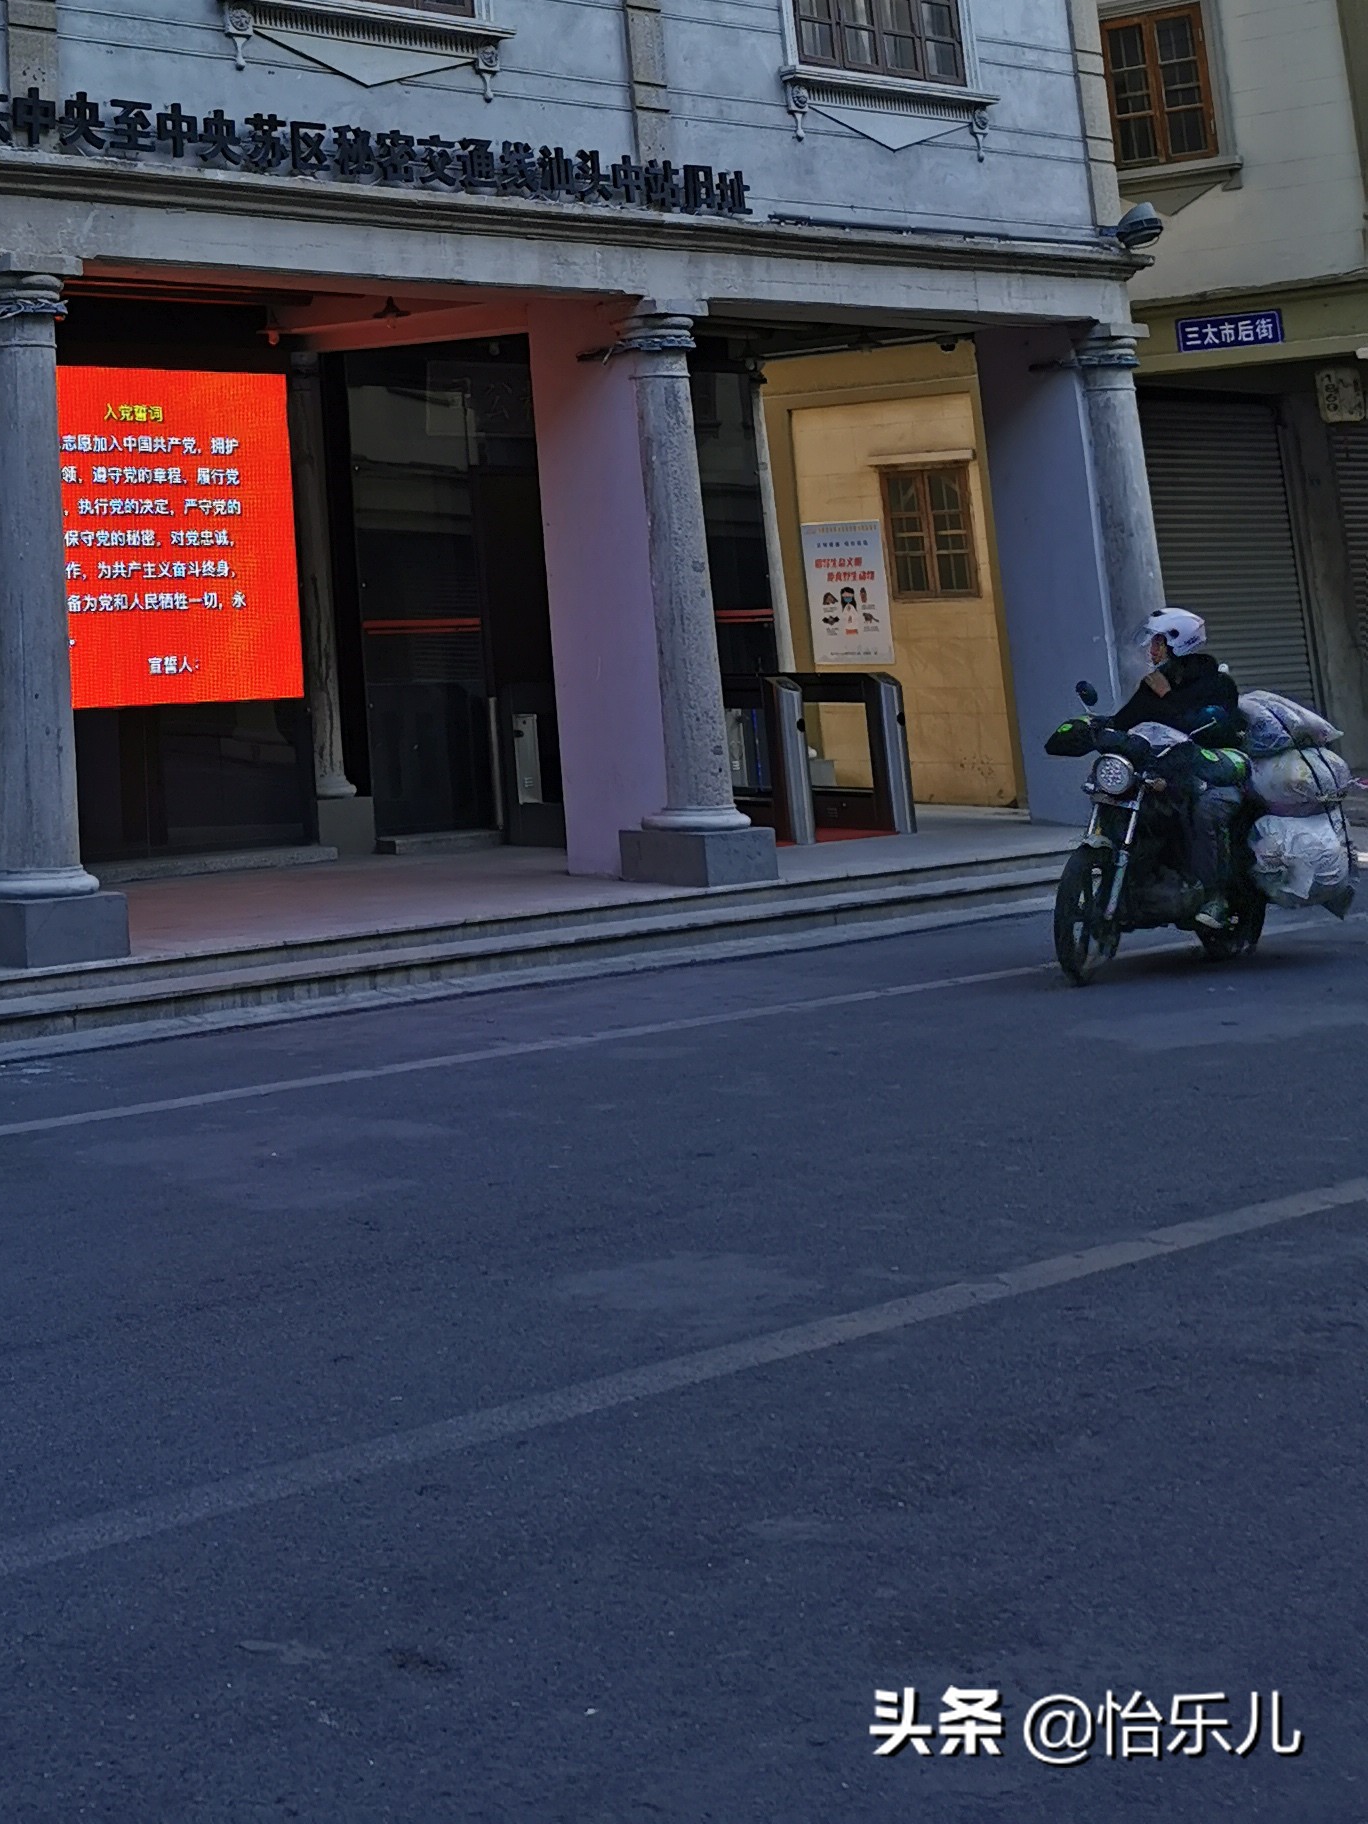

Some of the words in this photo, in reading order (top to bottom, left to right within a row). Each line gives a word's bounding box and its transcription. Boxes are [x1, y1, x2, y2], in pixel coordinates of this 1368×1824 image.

[1184, 318, 1274, 346] 三太市后街
[103, 402, 164, 422] 入党誓词
